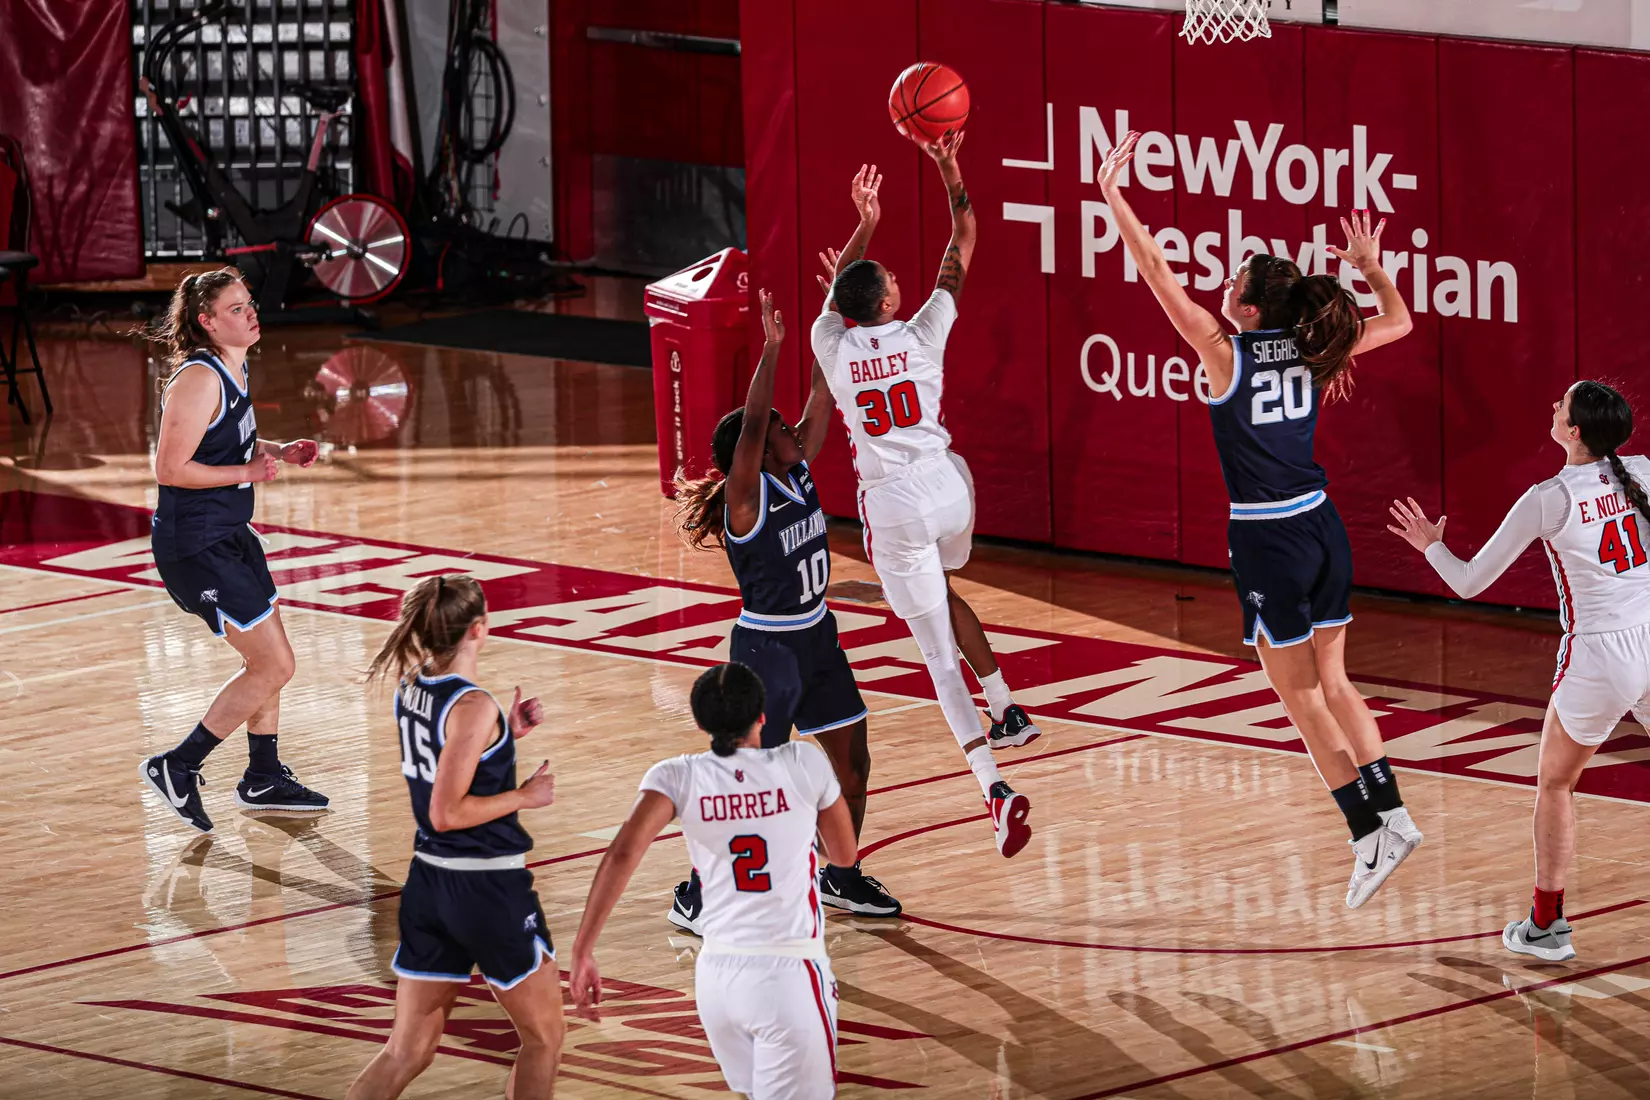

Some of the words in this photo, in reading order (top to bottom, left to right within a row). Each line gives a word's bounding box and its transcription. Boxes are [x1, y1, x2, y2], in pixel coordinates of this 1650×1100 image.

[1079, 105, 1417, 214] NewYork-
[849, 351, 908, 384] BAILEY
[1251, 365, 1312, 425] 20
[673, 381, 681, 413] back
[855, 379, 922, 437] 30
[1578, 500, 1595, 524] E.
[1598, 512, 1648, 575] 41
[797, 548, 828, 605] 10
[400, 715, 437, 783] 15
[700, 787, 791, 822] CORREA
[728, 833, 772, 893] 2
